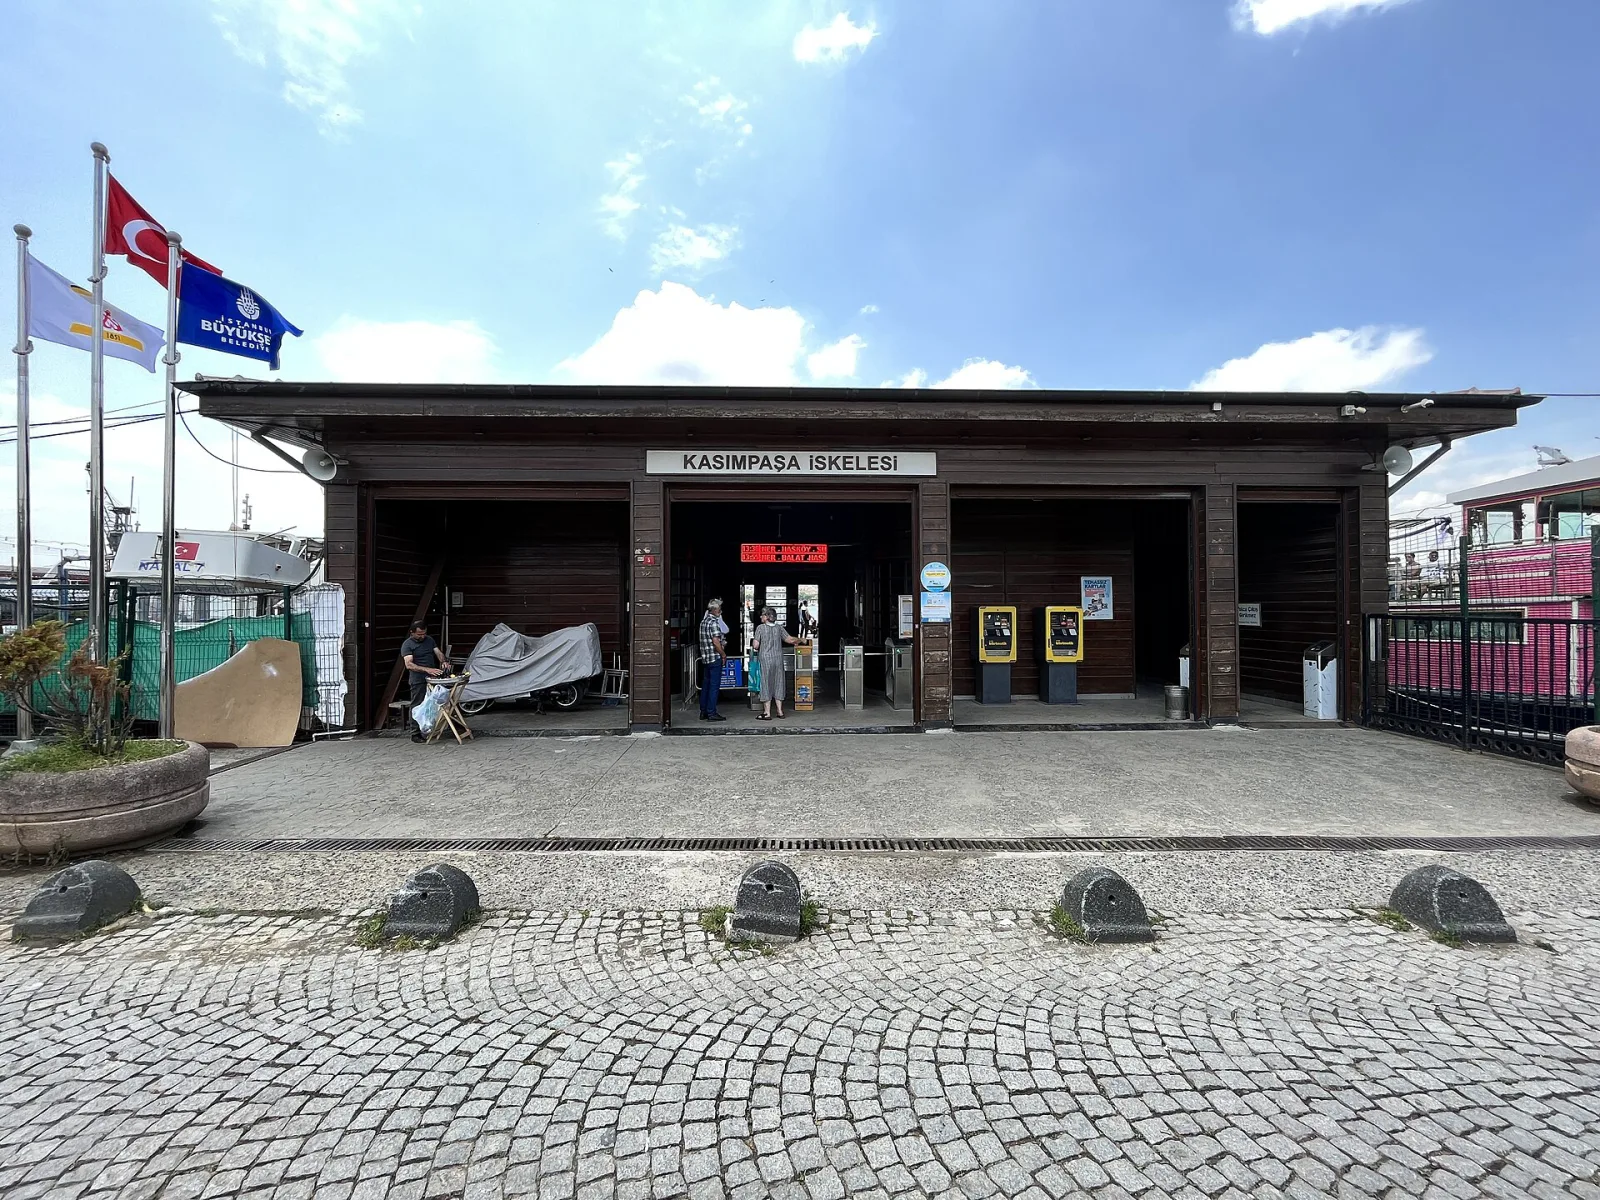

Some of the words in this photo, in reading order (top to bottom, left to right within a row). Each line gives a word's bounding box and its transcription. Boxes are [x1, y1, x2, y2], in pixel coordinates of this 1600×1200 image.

[683, 454, 801, 473] KASIMPAŞA
[808, 454, 898, 471] İSKELESİ
[138, 560, 191, 572] NAAL
[195, 562, 206, 573] 7
